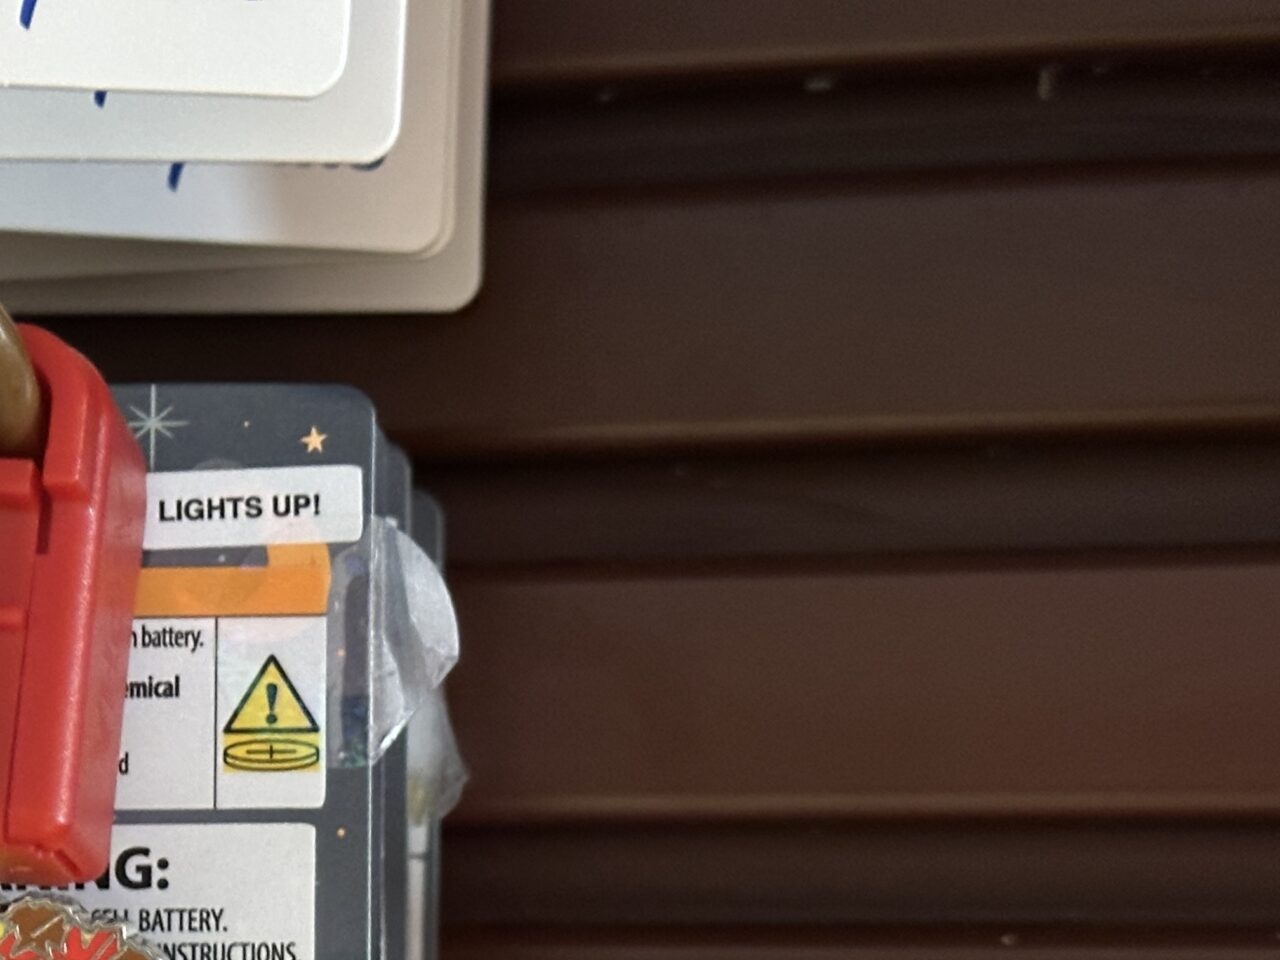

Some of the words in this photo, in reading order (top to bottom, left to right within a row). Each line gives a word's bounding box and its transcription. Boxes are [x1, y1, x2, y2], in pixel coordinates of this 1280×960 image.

[158, 496, 263, 521] LIGHTS
[272, 494, 321, 516] UP!
[141, 624, 205, 653] battery.
[124, 674, 180, 698] mical
[138, 907, 228, 933] BATTERY.
